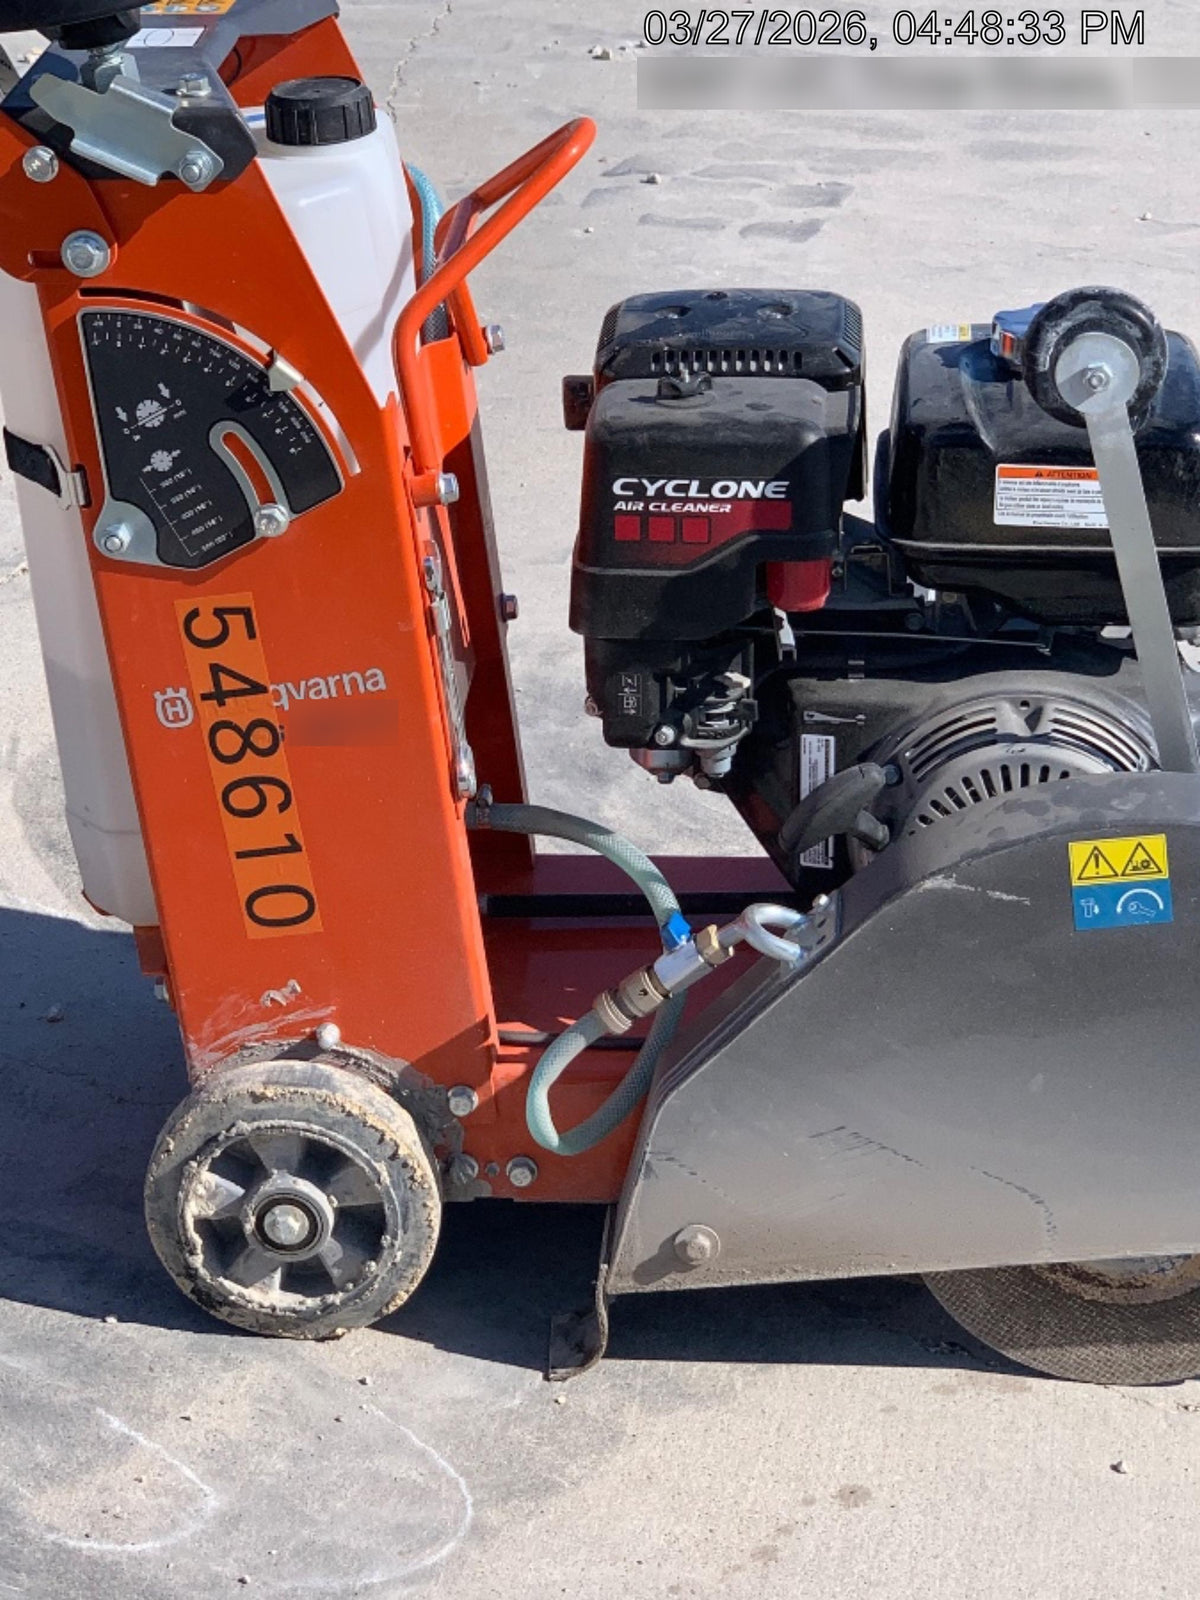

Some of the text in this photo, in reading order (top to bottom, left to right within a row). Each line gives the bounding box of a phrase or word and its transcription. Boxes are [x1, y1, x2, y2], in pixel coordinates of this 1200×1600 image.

[1046, 470, 1092, 480] ATTENTION
[612, 477, 791, 499] CYCLONE
[613, 501, 732, 513] AIR CLEANER
[269, 667, 387, 711] qvarna
[184, 607, 315, 927] 548610
